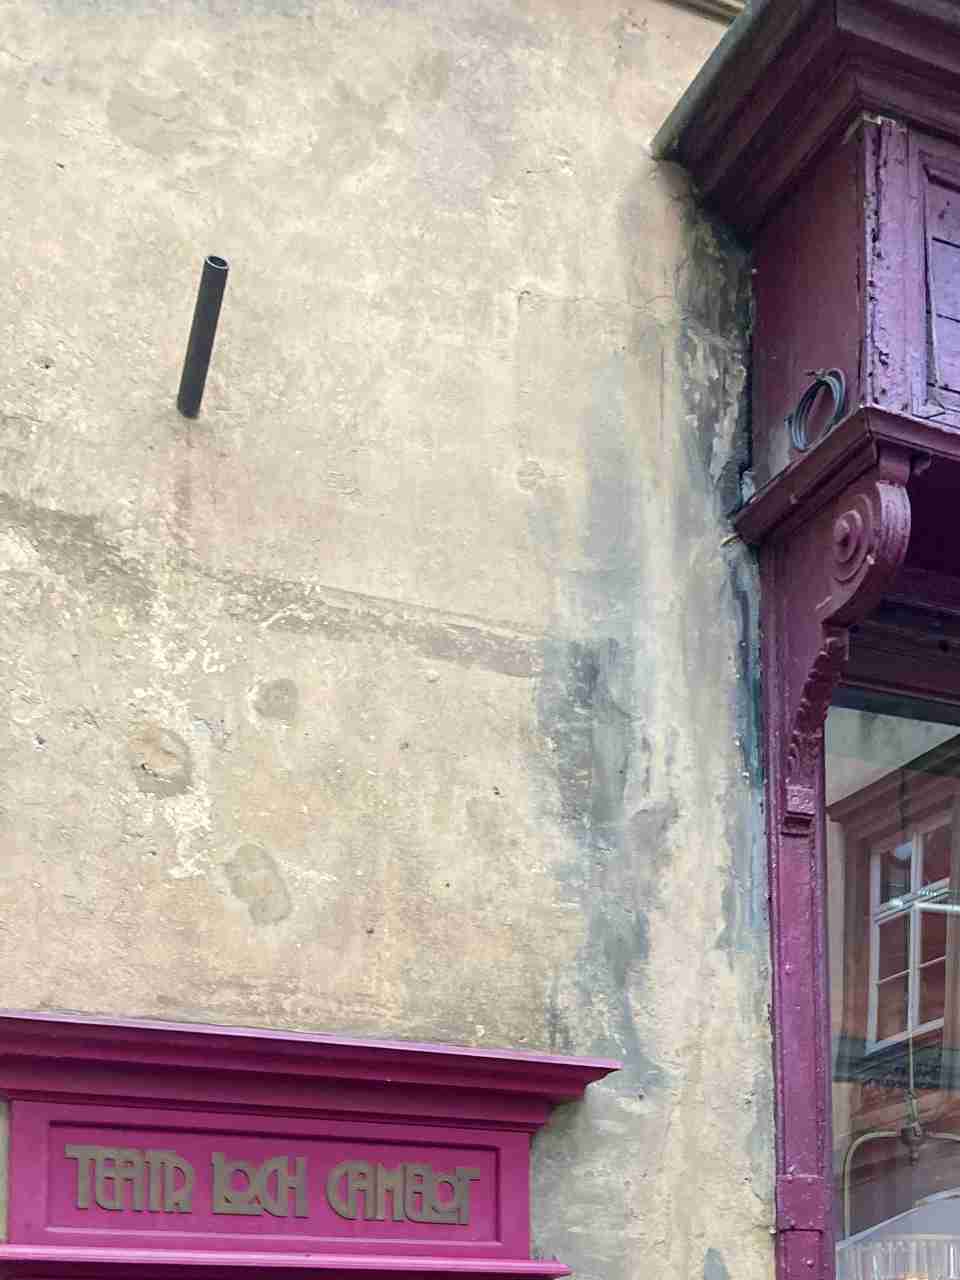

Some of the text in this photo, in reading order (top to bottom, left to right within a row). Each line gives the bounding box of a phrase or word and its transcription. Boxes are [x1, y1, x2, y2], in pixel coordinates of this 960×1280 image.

[64, 1144, 480, 1226] TEATR LOCH CAMELOT
